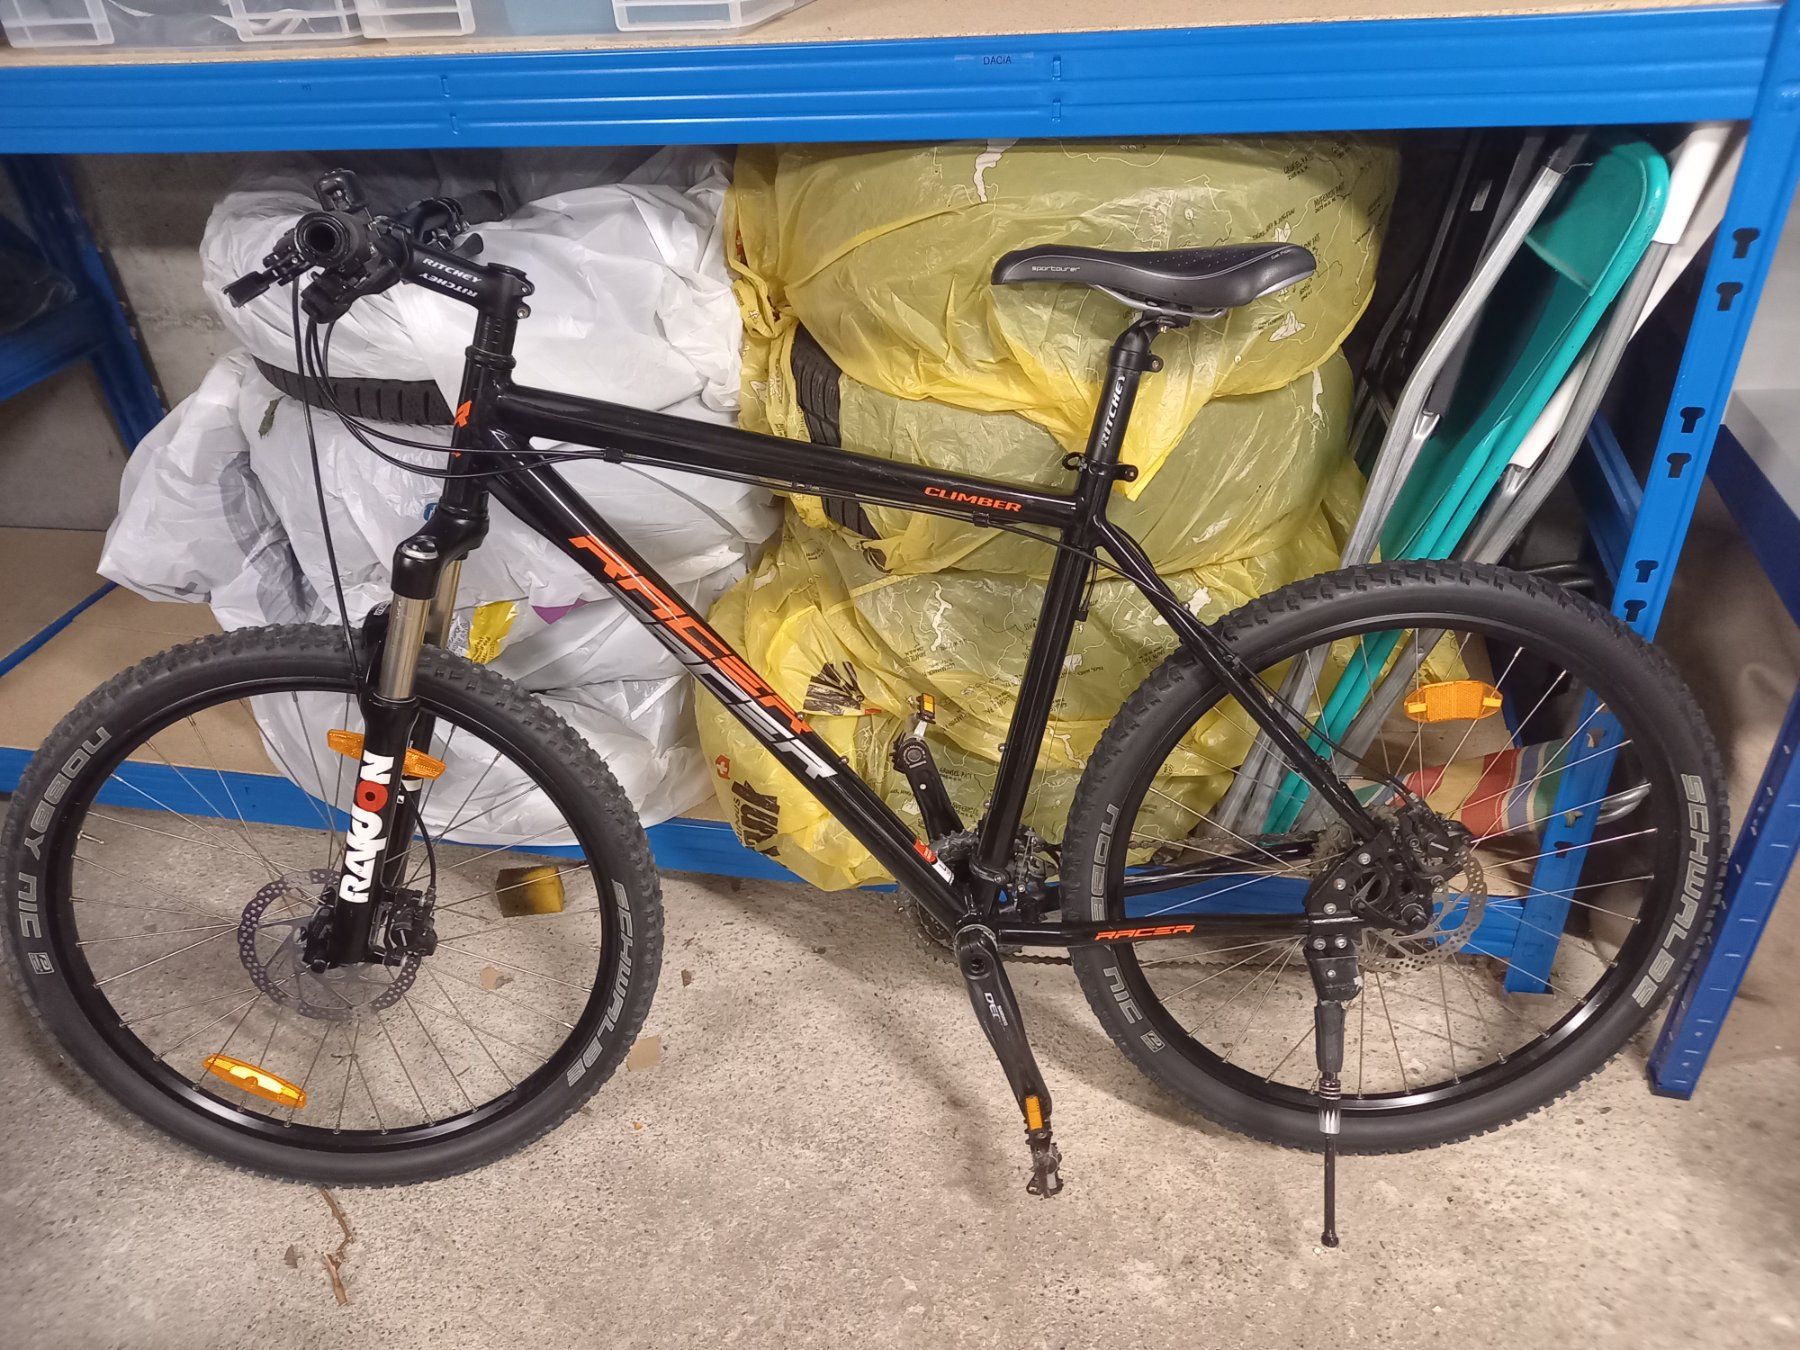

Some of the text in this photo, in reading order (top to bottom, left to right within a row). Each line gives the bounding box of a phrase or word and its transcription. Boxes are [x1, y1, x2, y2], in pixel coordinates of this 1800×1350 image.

[983, 55, 1012, 65] DACIA
[419, 272, 478, 297] RITCHEY
[422, 258, 482, 283] RITCHEY
[924, 486, 1022, 512] CLIMBER
[568, 534, 813, 734] RACER
[24, 726, 113, 861] NOBBY
[18, 871, 42, 939] NIC
[1091, 803, 1143, 1024] NOBB NIC
[1632, 773, 1710, 1008] SCHWALBE
[1094, 924, 1195, 942] RACER
[566, 878, 634, 1088] SCHWALBE
